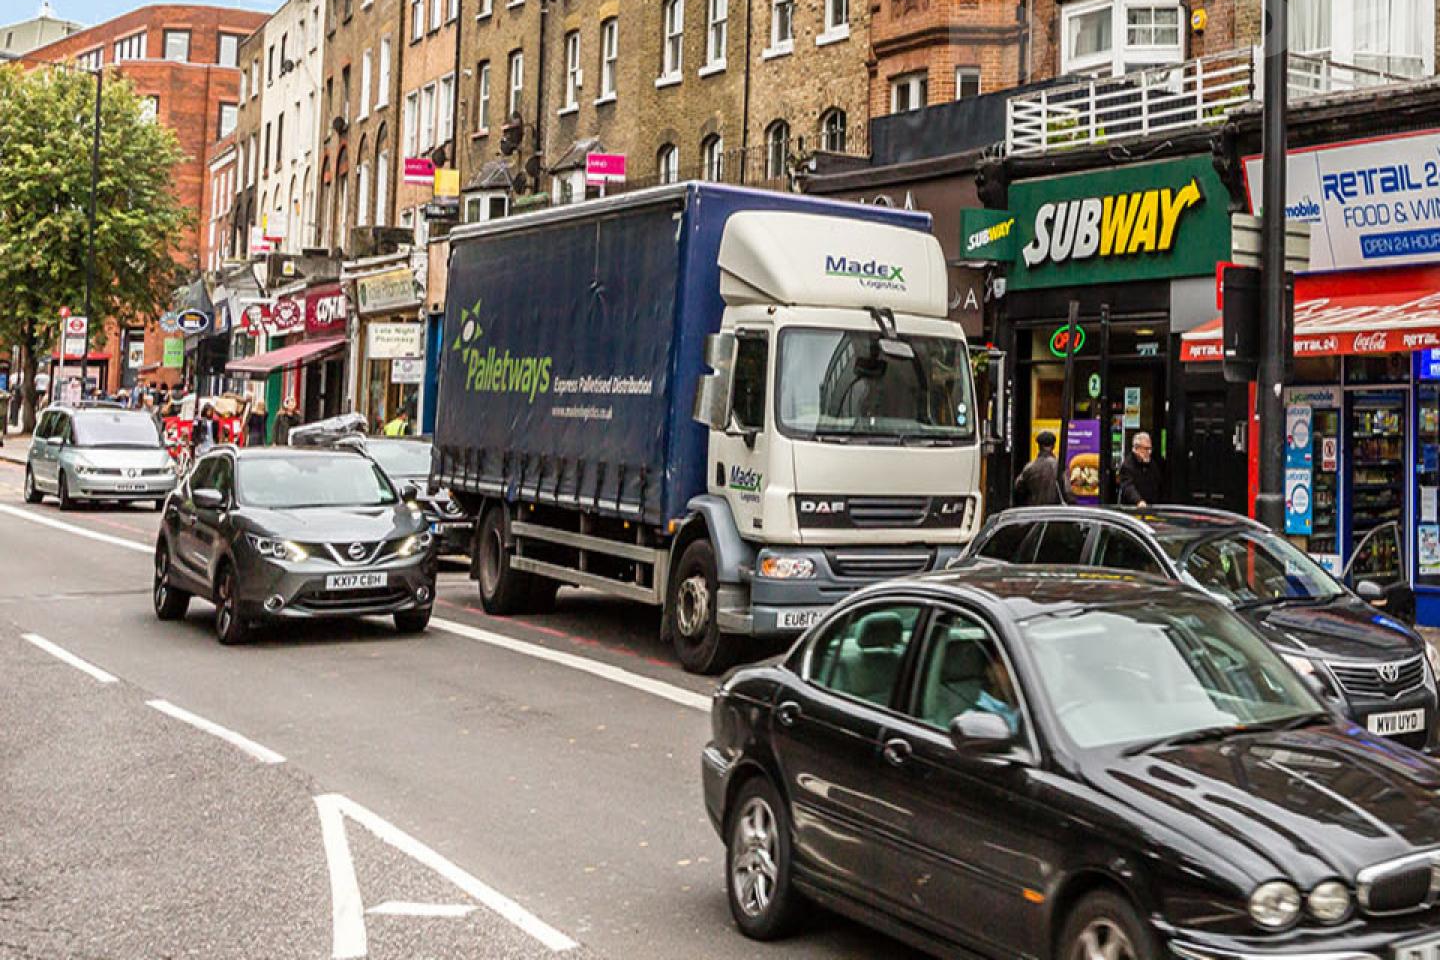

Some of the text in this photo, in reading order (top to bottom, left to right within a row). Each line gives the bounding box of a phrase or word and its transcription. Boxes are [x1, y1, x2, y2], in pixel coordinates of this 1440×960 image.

[1022, 177, 1201, 267] SUBWAY
[1343, 203, 1390, 228] FOOD
[1394, 201, 1408, 223] &
[967, 218, 1014, 251] SUBWAY
[1364, 239, 1392, 253] OPEN
[1395, 237, 1411, 251] 24
[860, 278, 907, 292] Logistics
[1353, 333, 1387, 352] Coca-Cola
[466, 347, 552, 404] Palletways
[612, 375, 652, 393] Distribution
[800, 500, 845, 514] DAF
[942, 503, 964, 514] LF
[1398, 714, 1418, 730] UYD
